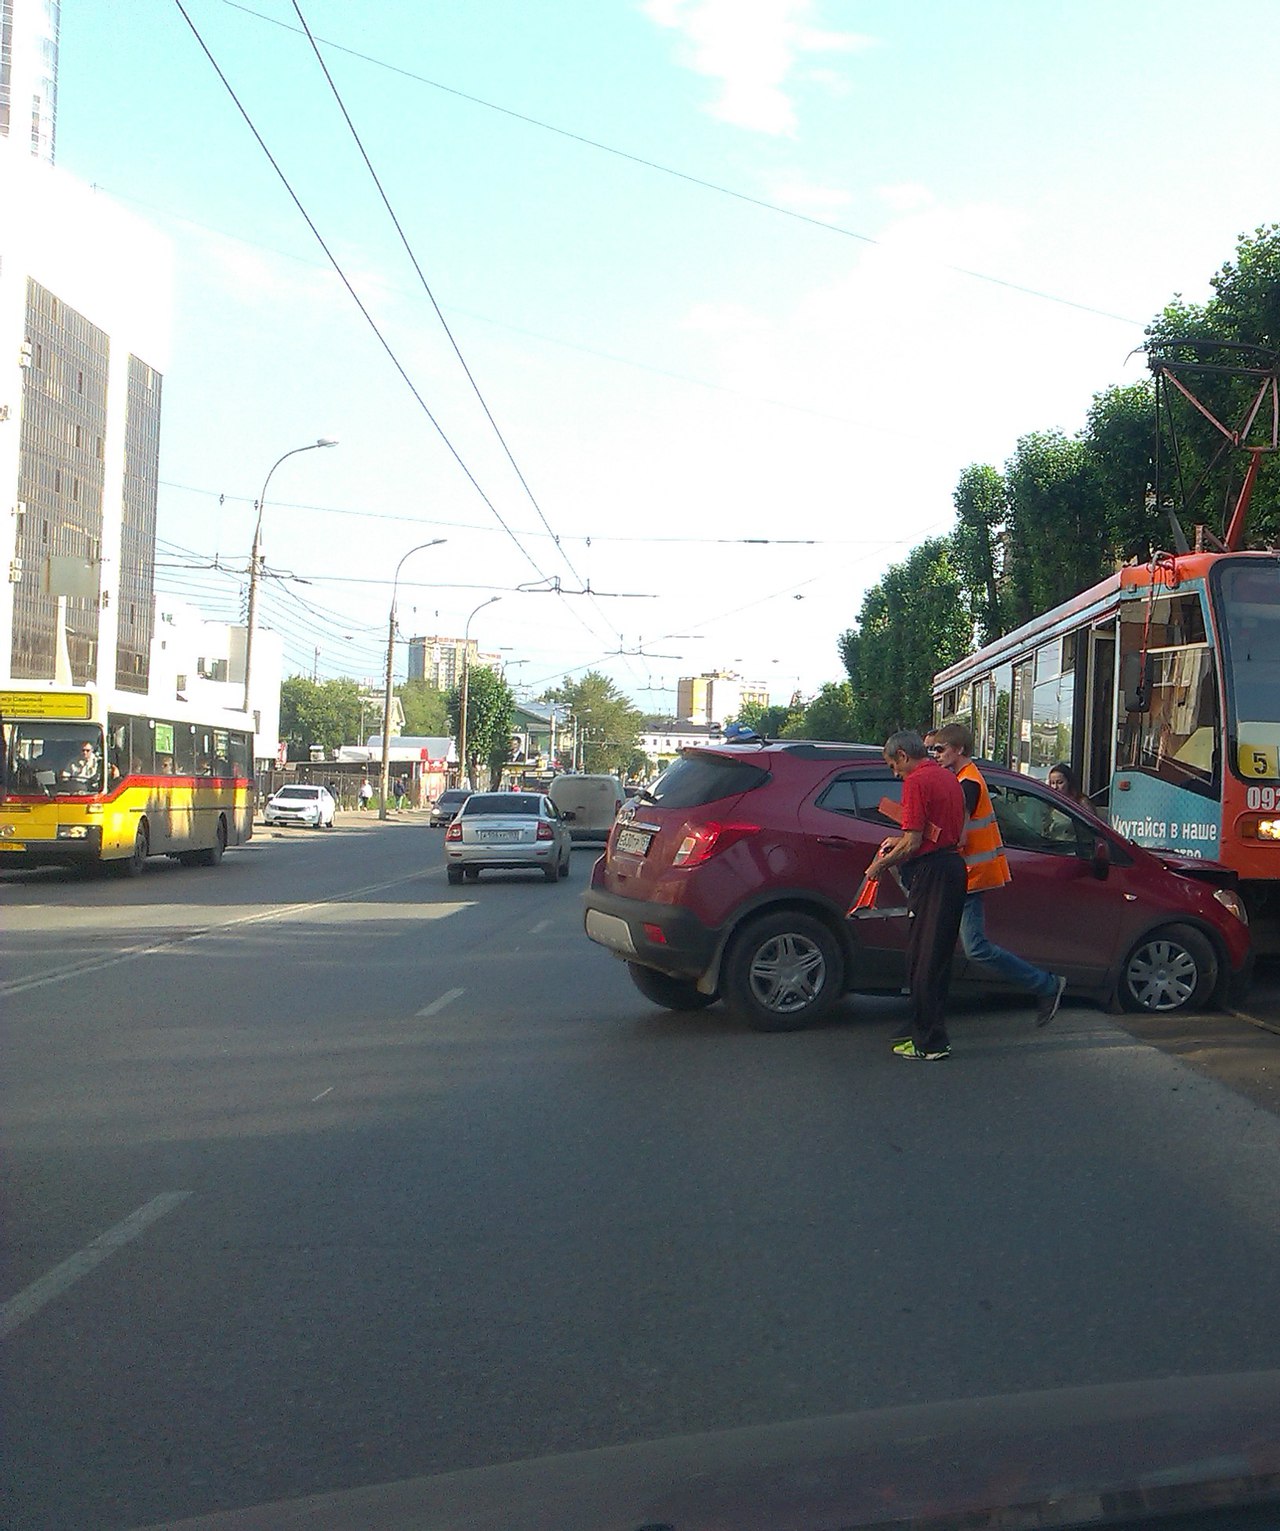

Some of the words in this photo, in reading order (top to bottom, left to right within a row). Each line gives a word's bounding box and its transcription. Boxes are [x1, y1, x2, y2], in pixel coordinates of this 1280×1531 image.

[1252, 752, 1268, 775] 5
[1111, 814, 1166, 839] Укутайся
[1170, 822, 1179, 838] в
[1182, 823, 1217, 841] наше
